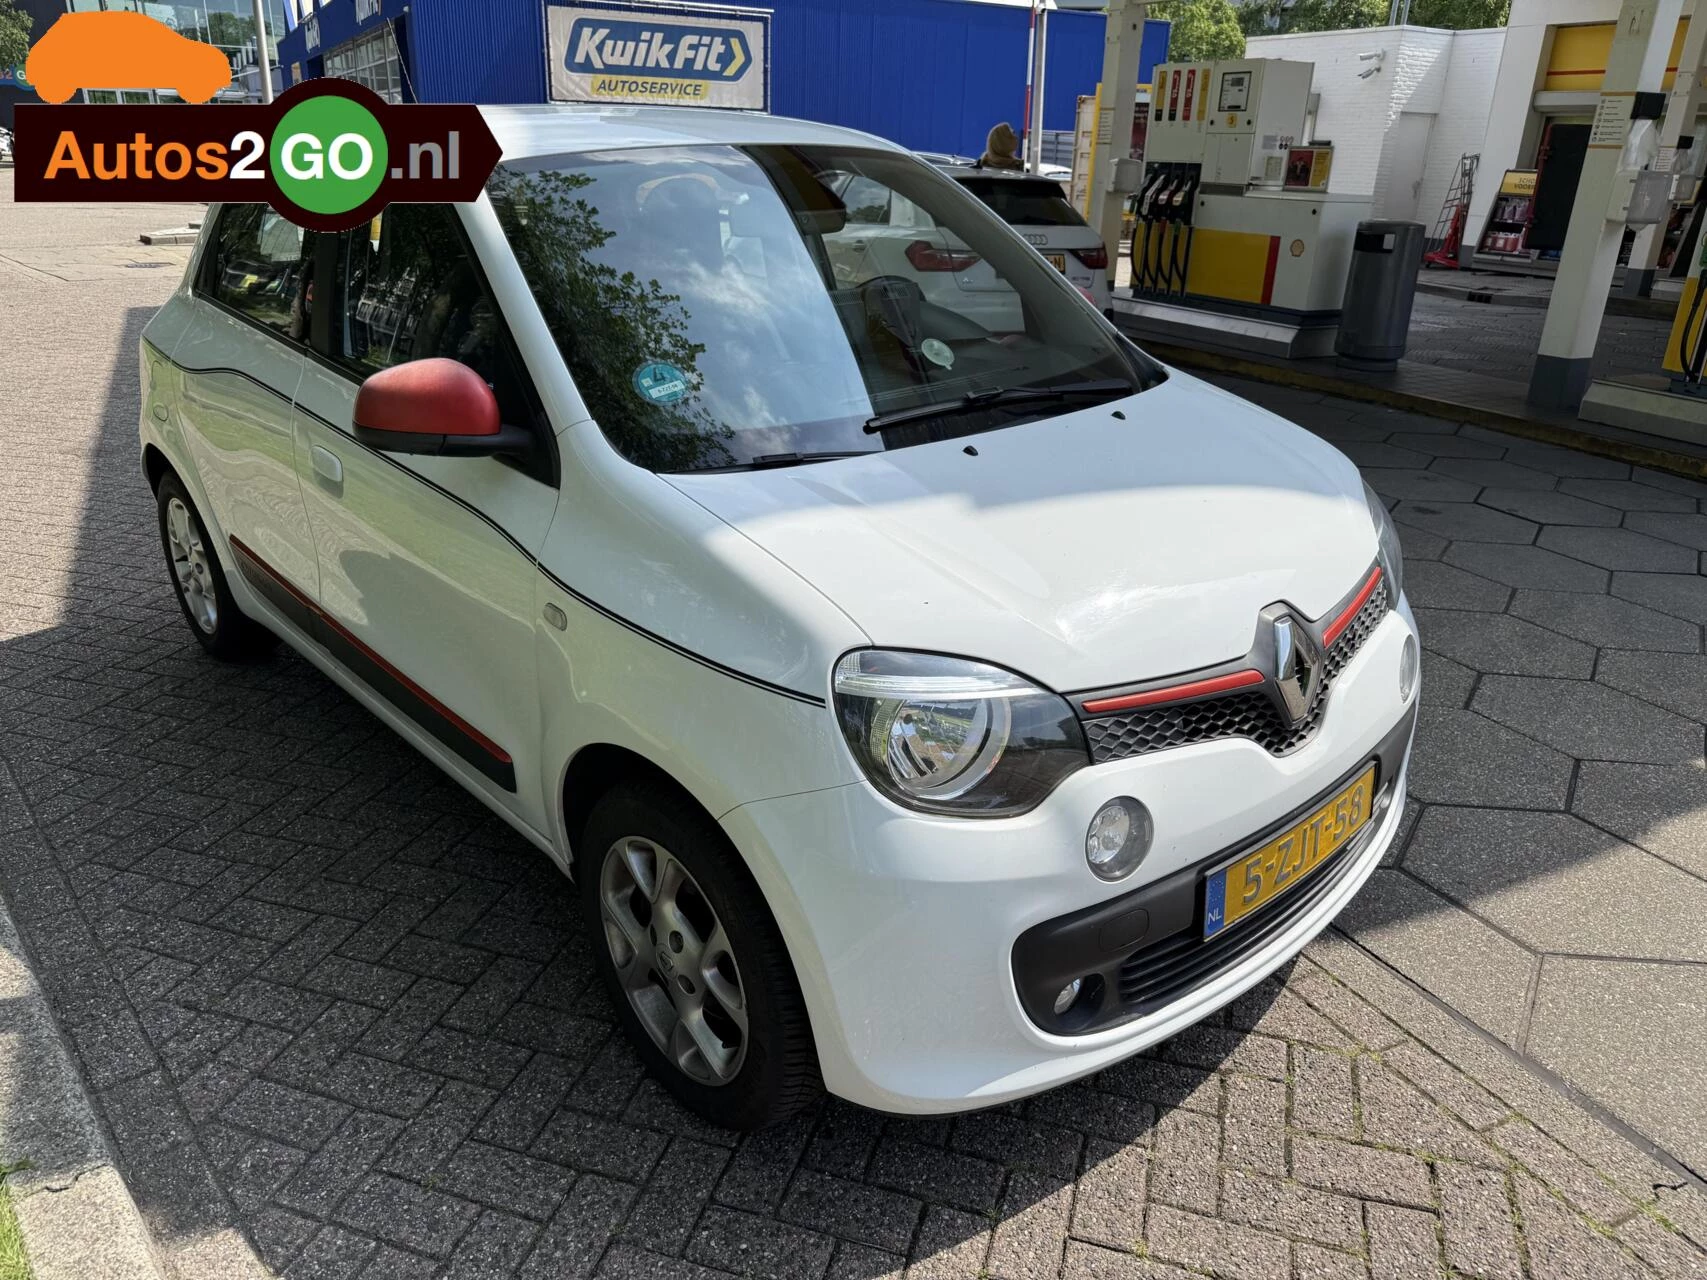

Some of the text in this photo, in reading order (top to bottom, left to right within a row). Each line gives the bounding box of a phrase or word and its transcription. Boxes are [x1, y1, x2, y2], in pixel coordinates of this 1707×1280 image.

[596, 79, 703, 96] AUTOSERVICE
[1243, 783, 1365, 905] 5-ZJT-58
[1206, 908, 1222, 925] NL
